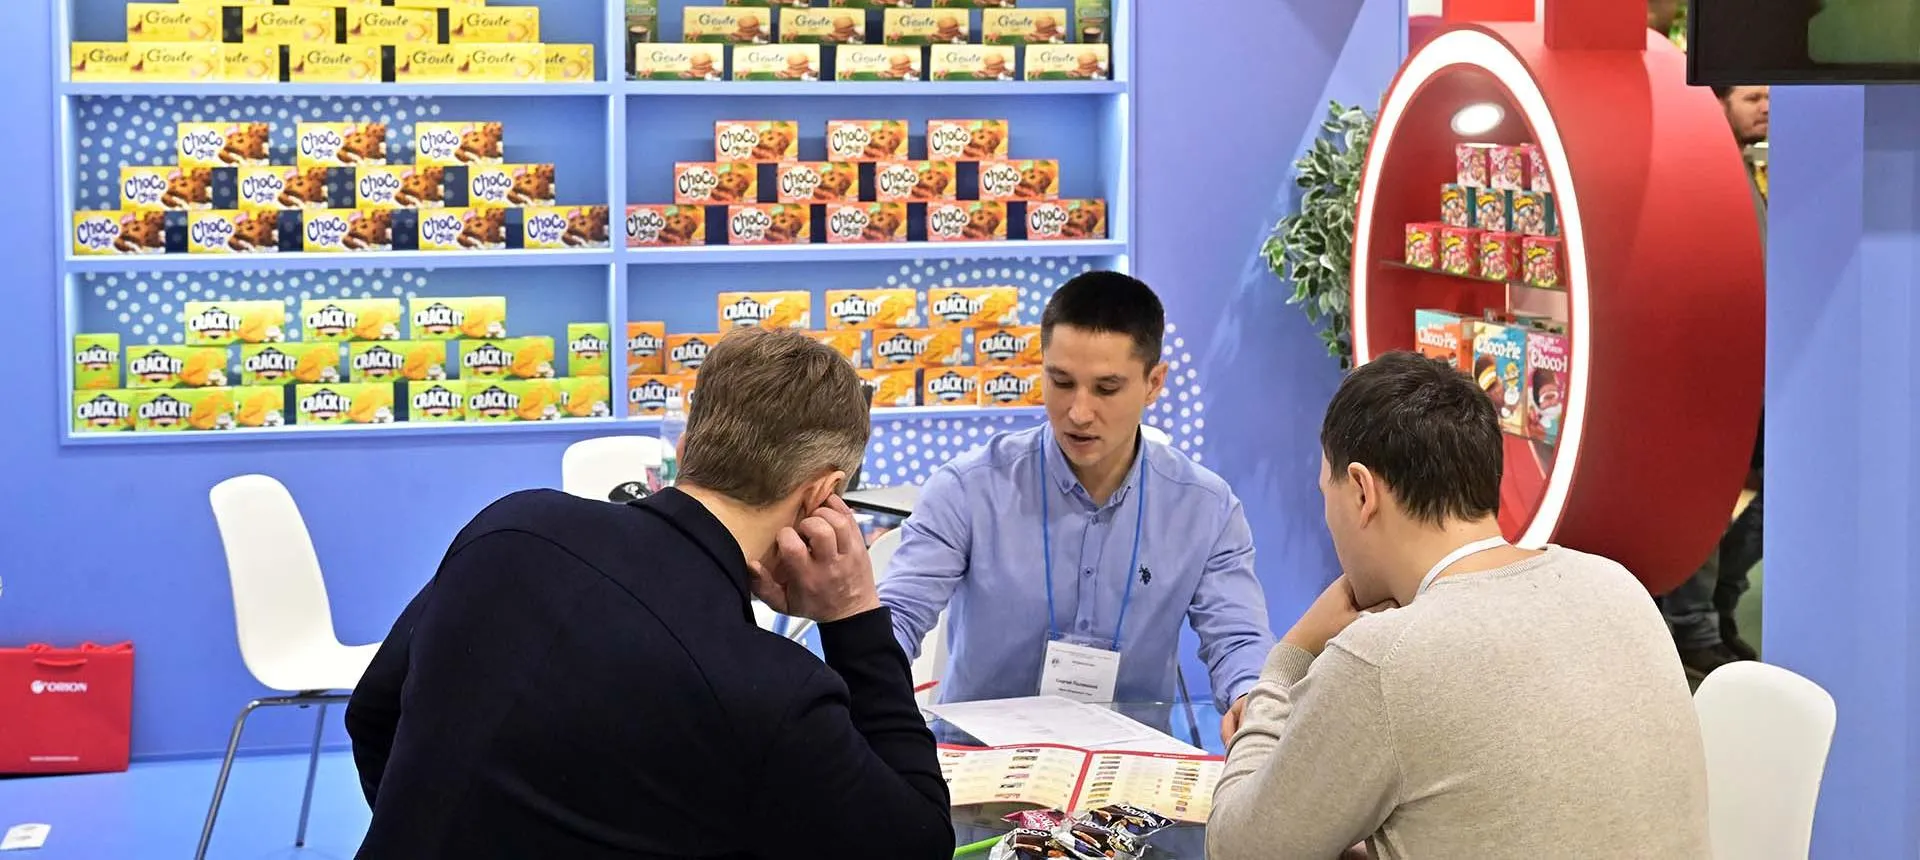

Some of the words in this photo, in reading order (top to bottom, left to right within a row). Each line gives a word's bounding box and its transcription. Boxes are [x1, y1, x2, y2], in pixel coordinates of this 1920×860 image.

[88, 48, 128, 63] Gout
[182, 130, 223, 155] Choco
[301, 130, 341, 155] Choco
[420, 130, 459, 154] Choco
[720, 129, 756, 152] Choco
[832, 128, 868, 151] Choco
[932, 128, 968, 150] Choco
[125, 174, 166, 199] Choco
[242, 174, 283, 199] Choco
[360, 174, 399, 198] Choco
[472, 172, 512, 197] Choco
[678, 170, 716, 194] Choco
[782, 169, 818, 192] Choco
[880, 168, 916, 190] Choco
[984, 168, 1019, 190] Choco
[422, 215, 462, 240] Choco
[527, 214, 566, 239] Choco
[626, 212, 664, 236] Choco
[732, 212, 770, 236] Choco
[830, 211, 867, 234] Choco
[932, 208, 967, 232] Choco
[1031, 207, 1066, 230] Choco
[77, 219, 118, 244] Choco
[192, 218, 233, 244] Choco
[307, 217, 347, 242] Choco
[414, 308, 452, 325] CRACK
[724, 304, 758, 320] CRACK
[830, 300, 866, 316] CRACK
[934, 298, 969, 315] CRACK
[190, 312, 229, 330] CRACK
[310, 311, 344, 328] CRACK
[569, 339, 599, 352] CRACK
[627, 336, 655, 350] CRACK
[878, 339, 914, 356] CRACK
[980, 337, 1015, 354] CRACK
[76, 350, 108, 364] CRACK
[130, 357, 170, 374] CRACK
[246, 354, 284, 372] CRACK
[354, 352, 392, 369] CRACK
[464, 350, 501, 368] CRACK
[628, 385, 666, 403] CRACK
[928, 377, 964, 393] CRACK
[984, 378, 1020, 394] CRACK
[78, 401, 118, 419] CRACK
[140, 401, 179, 419] CRACK
[302, 396, 339, 414] CRACK
[414, 392, 450, 409] CRACK
[470, 392, 509, 410] CRACK
